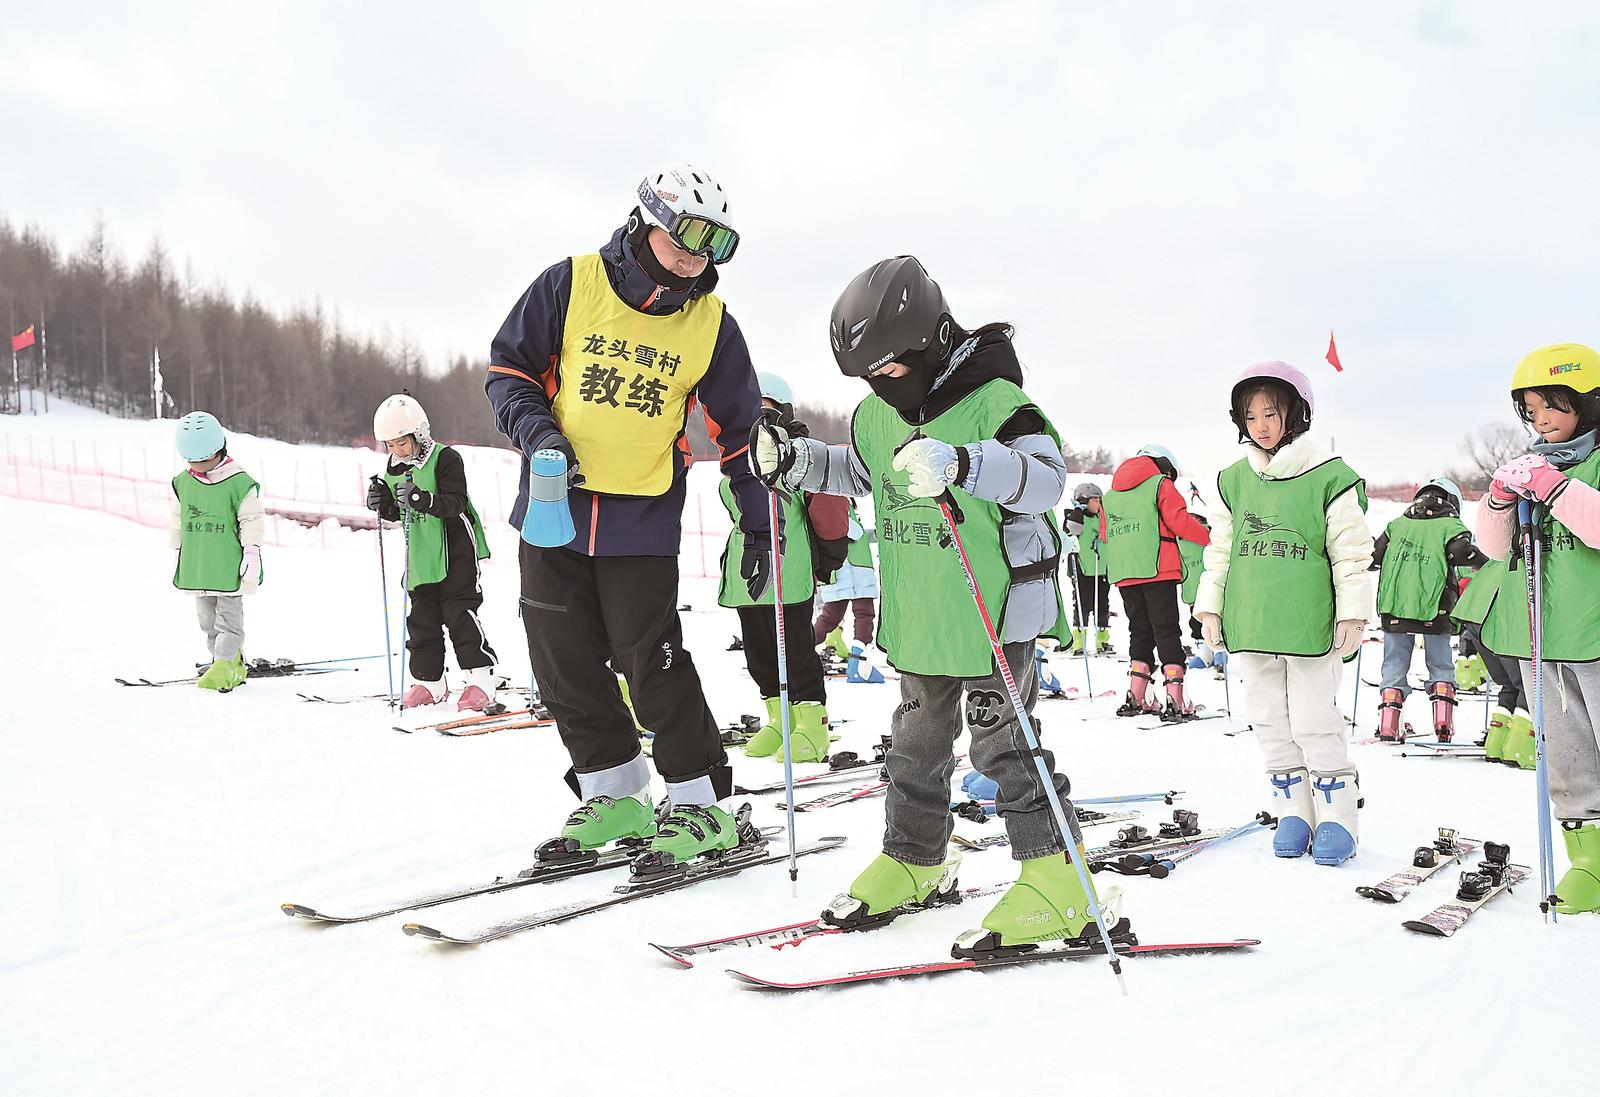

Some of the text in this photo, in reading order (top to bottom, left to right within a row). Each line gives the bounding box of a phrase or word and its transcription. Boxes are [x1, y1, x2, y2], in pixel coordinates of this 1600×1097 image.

[581, 333, 682, 377] 龙头雪村
[579, 363, 669, 418] 教练
[1239, 539, 1309, 561] 通化雪村
